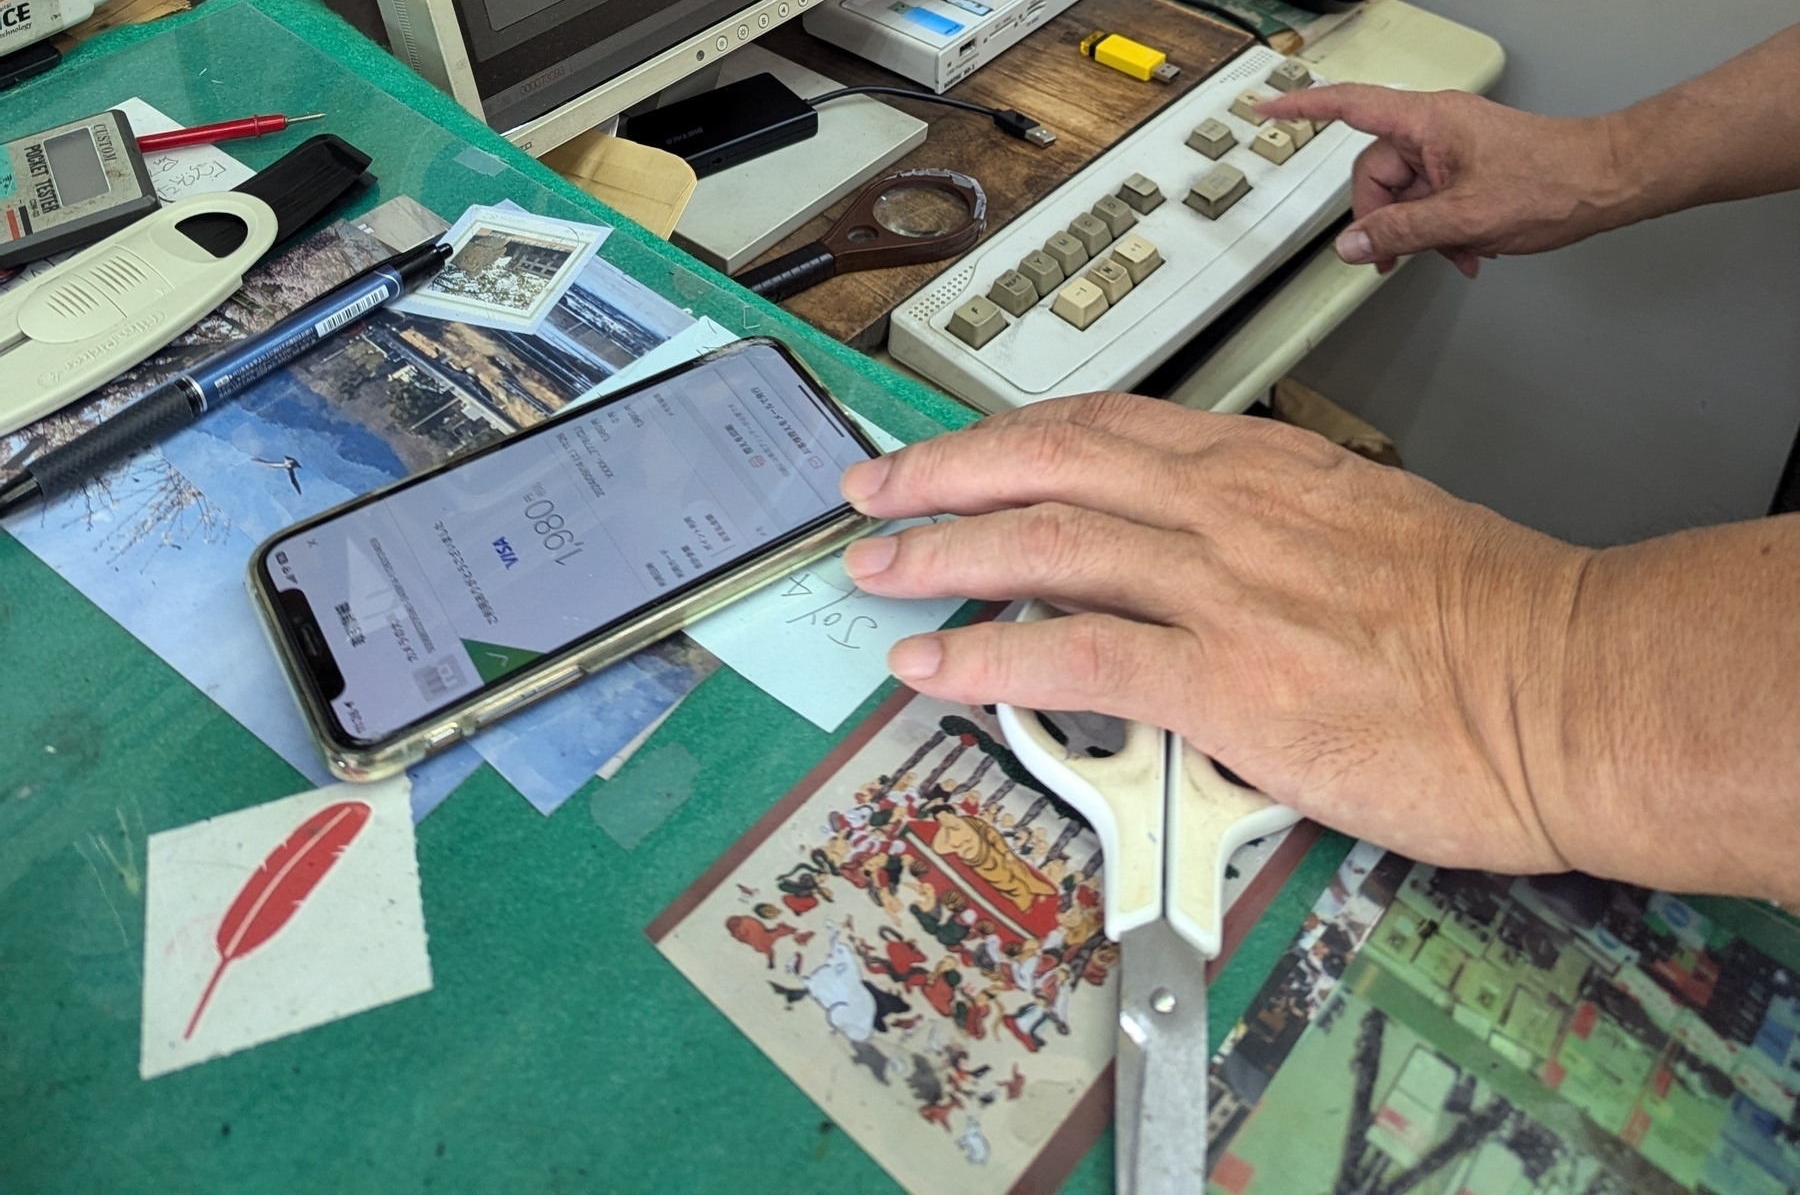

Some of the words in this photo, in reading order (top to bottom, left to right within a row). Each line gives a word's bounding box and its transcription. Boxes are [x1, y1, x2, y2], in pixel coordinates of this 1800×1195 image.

[24, 143, 49, 177] POCKET
[92, 123, 118, 162] CUSTOM
[35, 178, 60, 214] TESTER
[520, 495, 590, 569] 1,980
[489, 535, 521, 571] VISA
